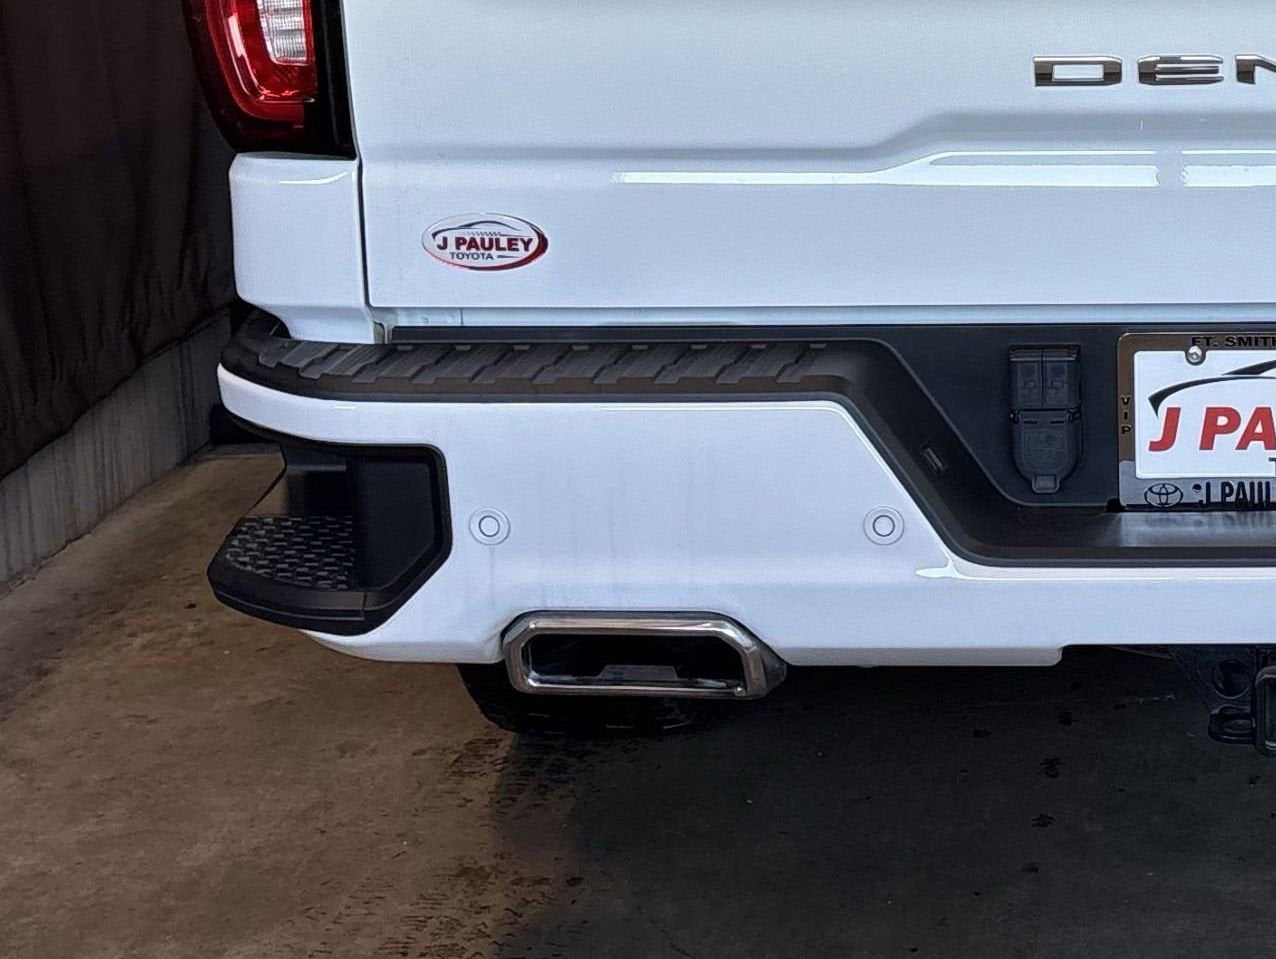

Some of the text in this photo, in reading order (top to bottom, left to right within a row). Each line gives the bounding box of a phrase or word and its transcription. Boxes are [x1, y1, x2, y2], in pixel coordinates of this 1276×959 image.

[436, 236, 534, 252] J PAULEY
[448, 251, 495, 261] TOYOTA
[1148, 406, 1182, 452] J
